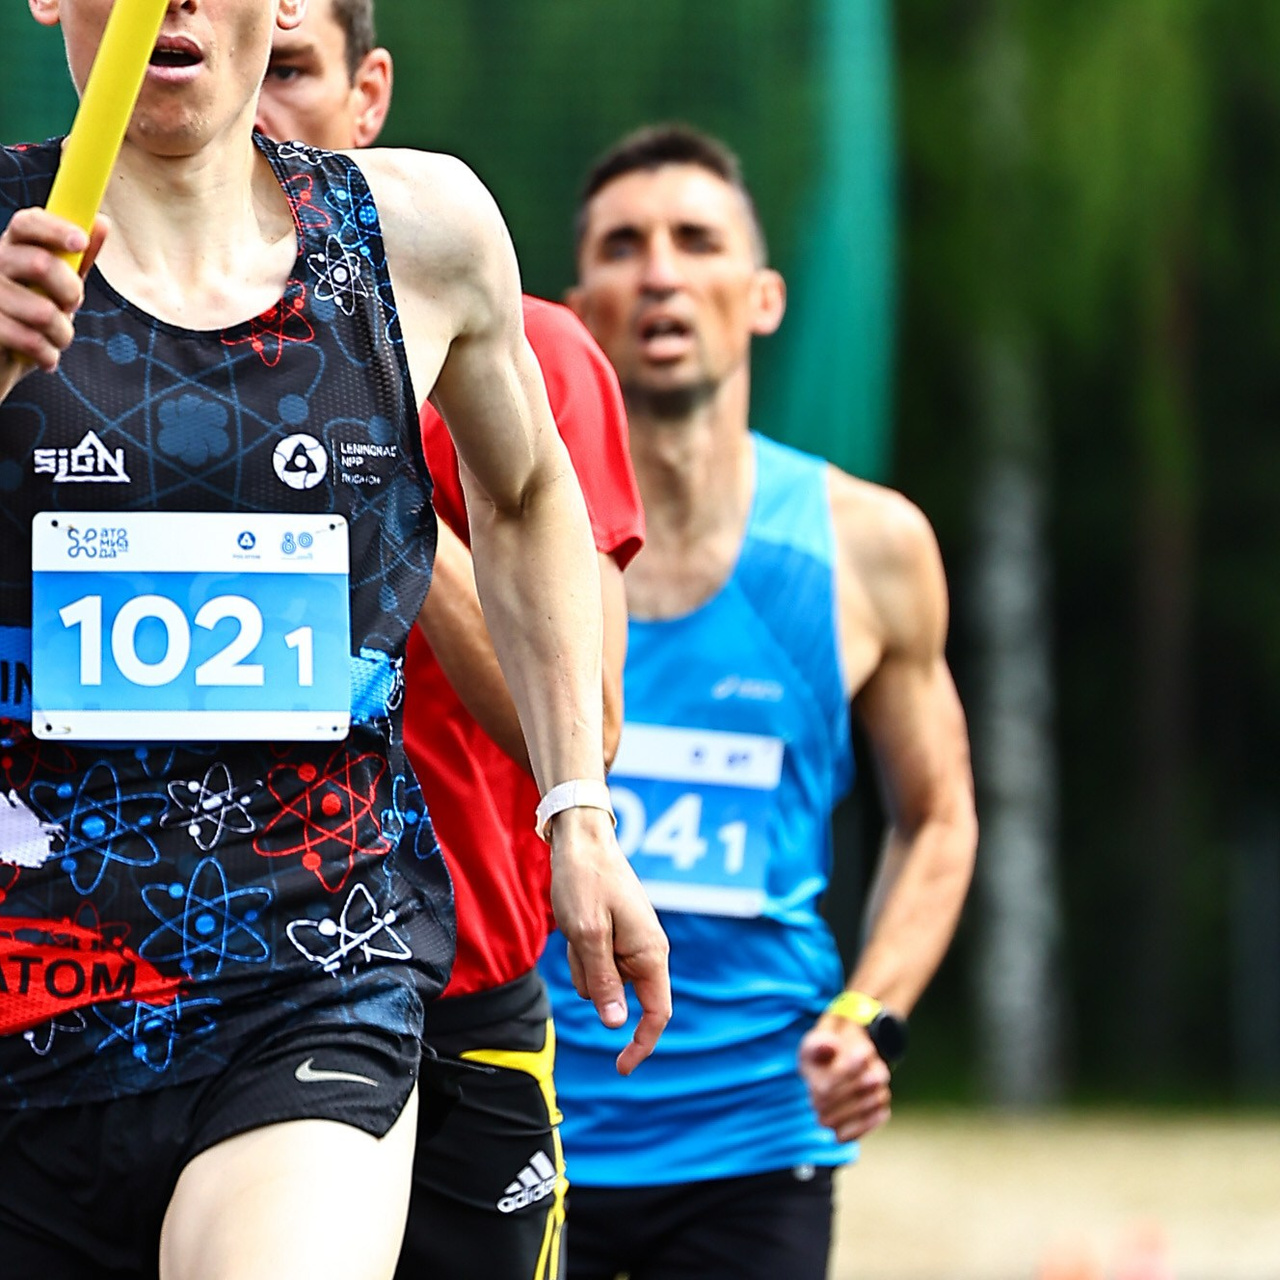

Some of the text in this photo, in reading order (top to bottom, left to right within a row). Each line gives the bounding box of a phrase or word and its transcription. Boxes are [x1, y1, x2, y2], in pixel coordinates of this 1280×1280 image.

[340, 442, 397, 458] LENINGRAD
[341, 455, 365, 468] NPP
[59, 593, 314, 687] 102 1
[607, 784, 748, 875] 04 1
